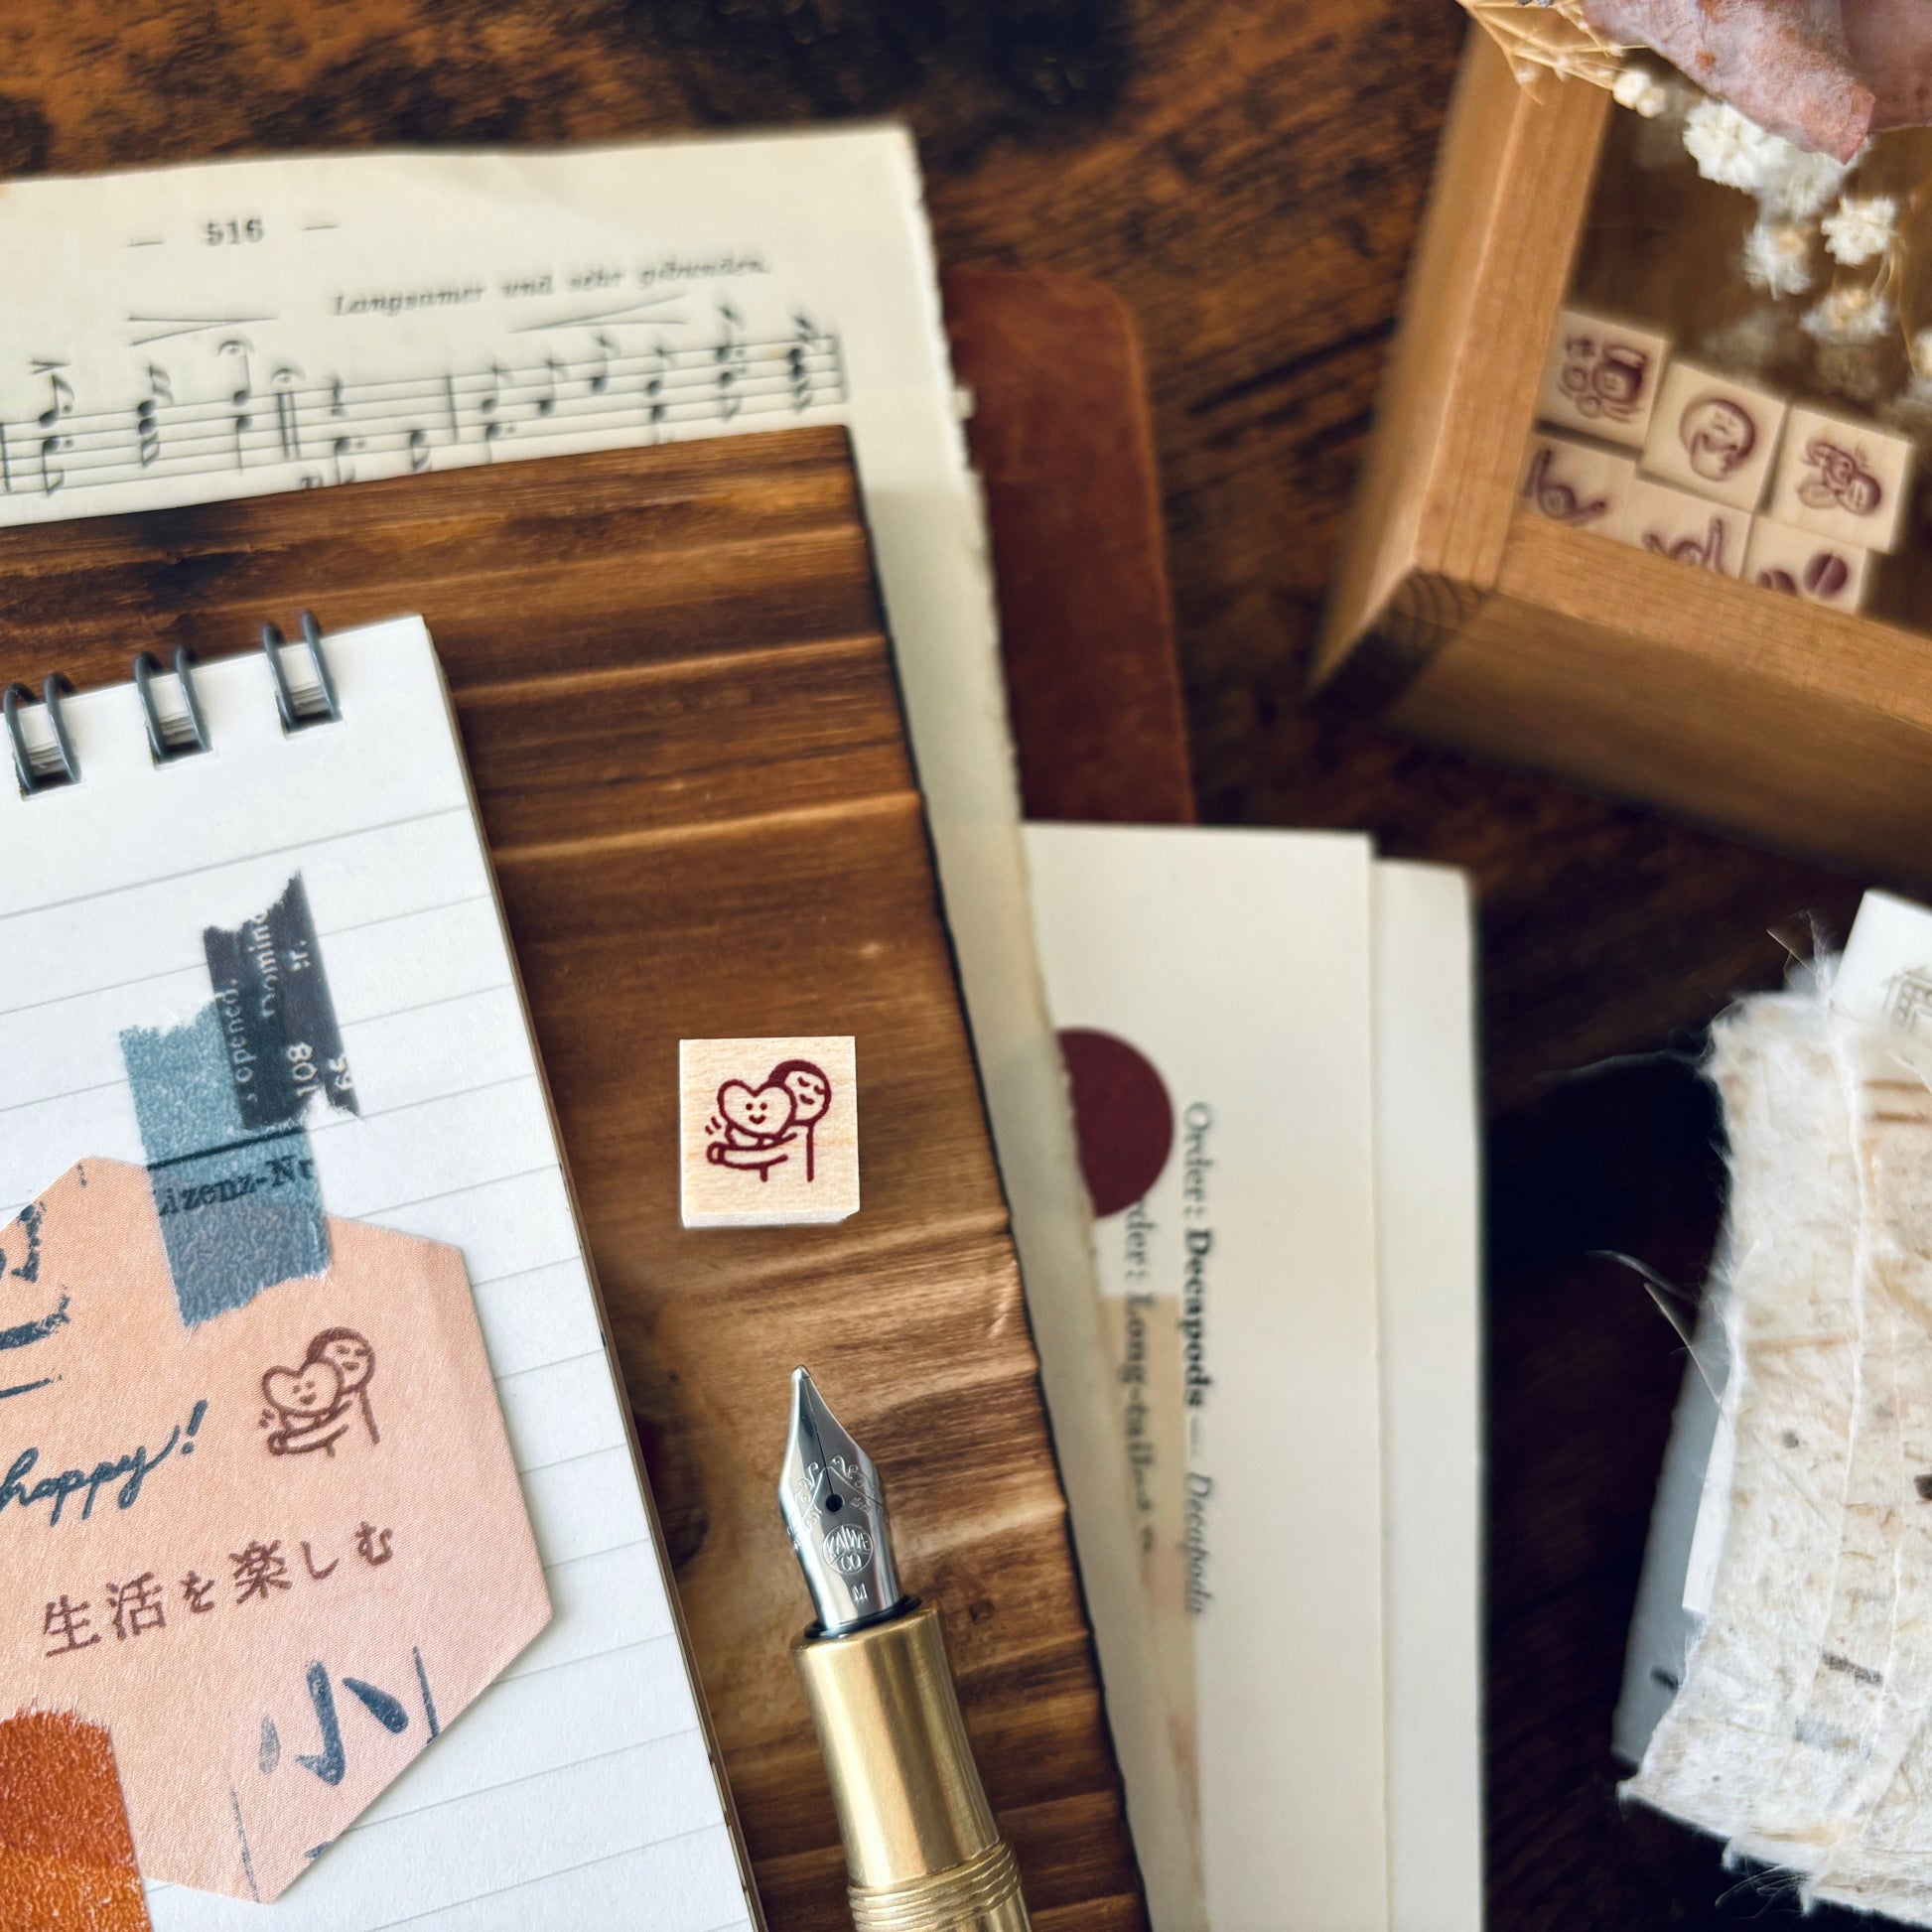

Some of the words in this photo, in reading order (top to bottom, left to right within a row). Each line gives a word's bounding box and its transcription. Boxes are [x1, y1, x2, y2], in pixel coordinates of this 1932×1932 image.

[207, 216, 264, 246] 516
[286, 1042, 319, 1097] 108
[1183, 1102, 1214, 1219] Order:
[1175, 1229, 1214, 1409] Decapods
[43, 1520, 394, 1659] 生活を楽しむ
[853, 1584, 869, 1602] M
